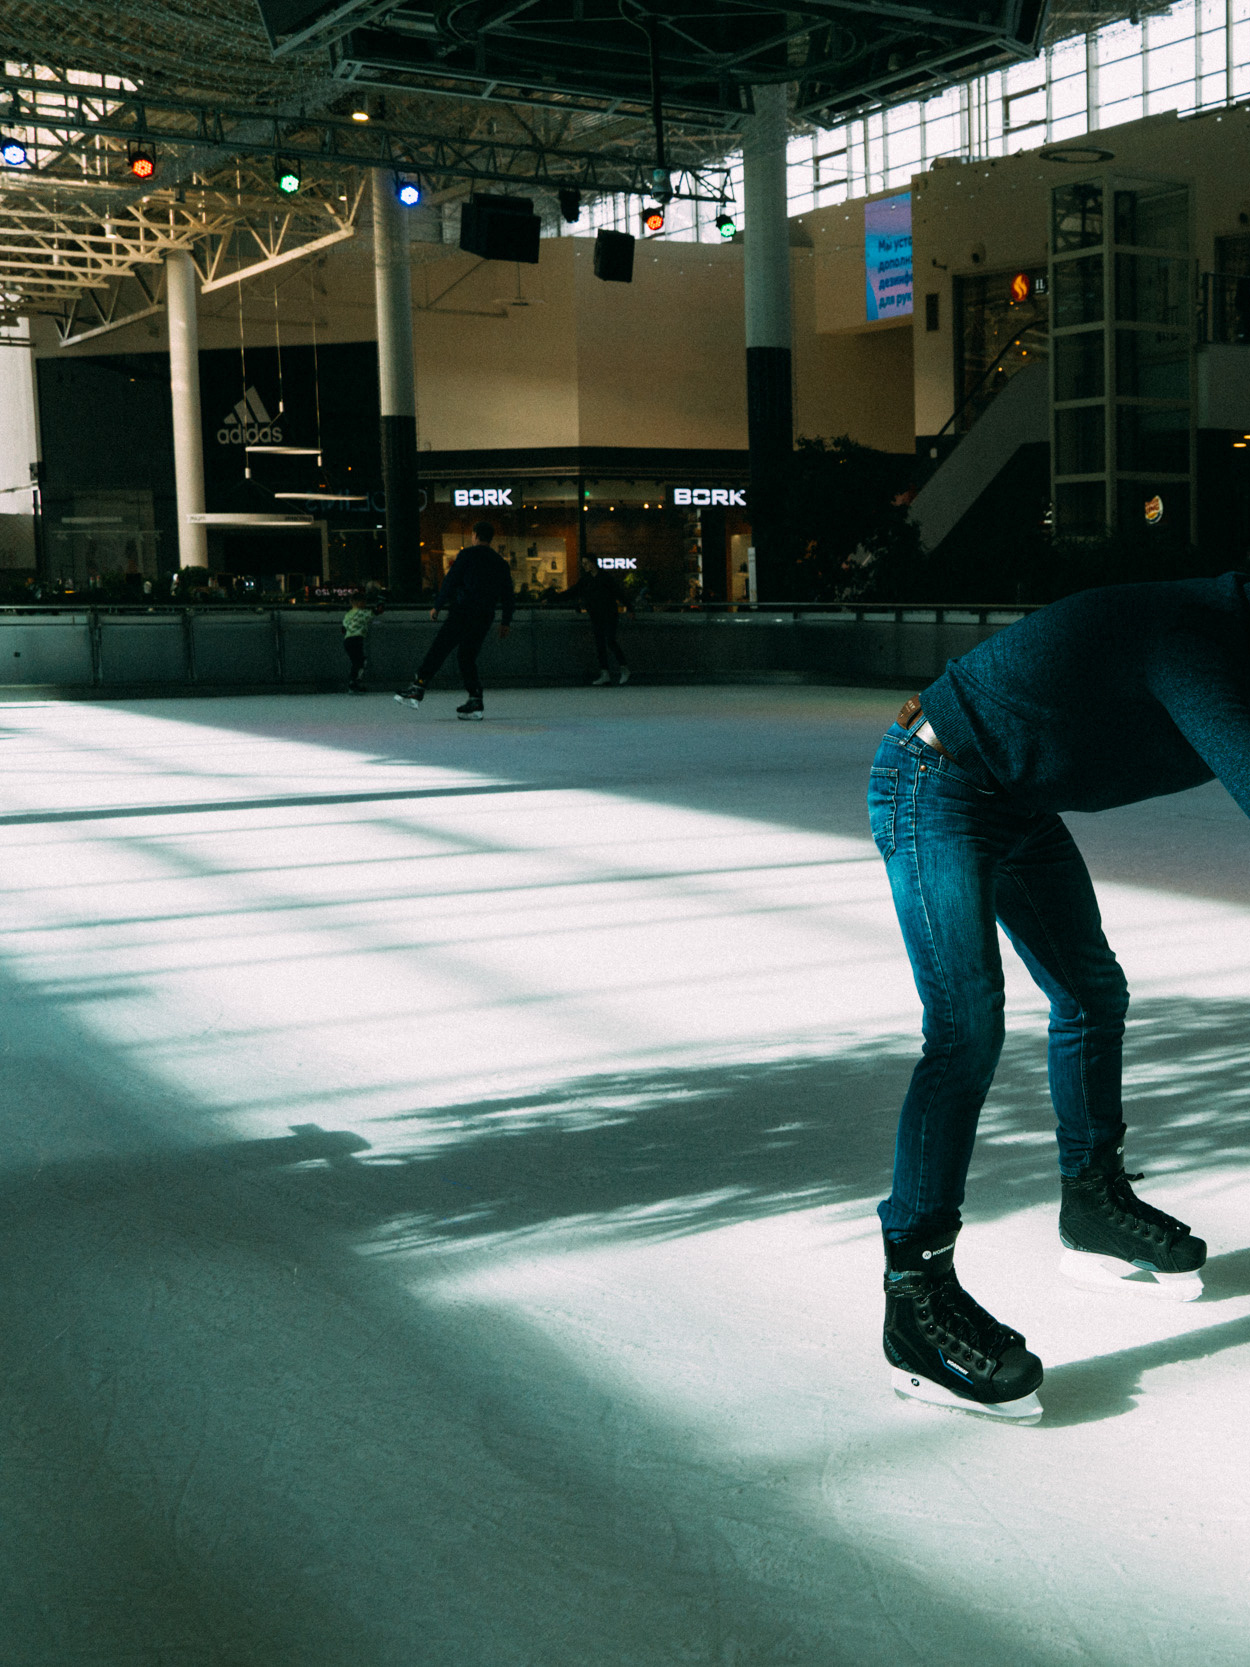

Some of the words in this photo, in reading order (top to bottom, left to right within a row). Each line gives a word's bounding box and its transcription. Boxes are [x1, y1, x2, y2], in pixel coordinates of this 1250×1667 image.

[879, 296, 895, 310] для
[896, 293, 912, 307] рук
[217, 424, 283, 444] adidas
[454, 488, 513, 507] BORK
[673, 488, 747, 506] BORK
